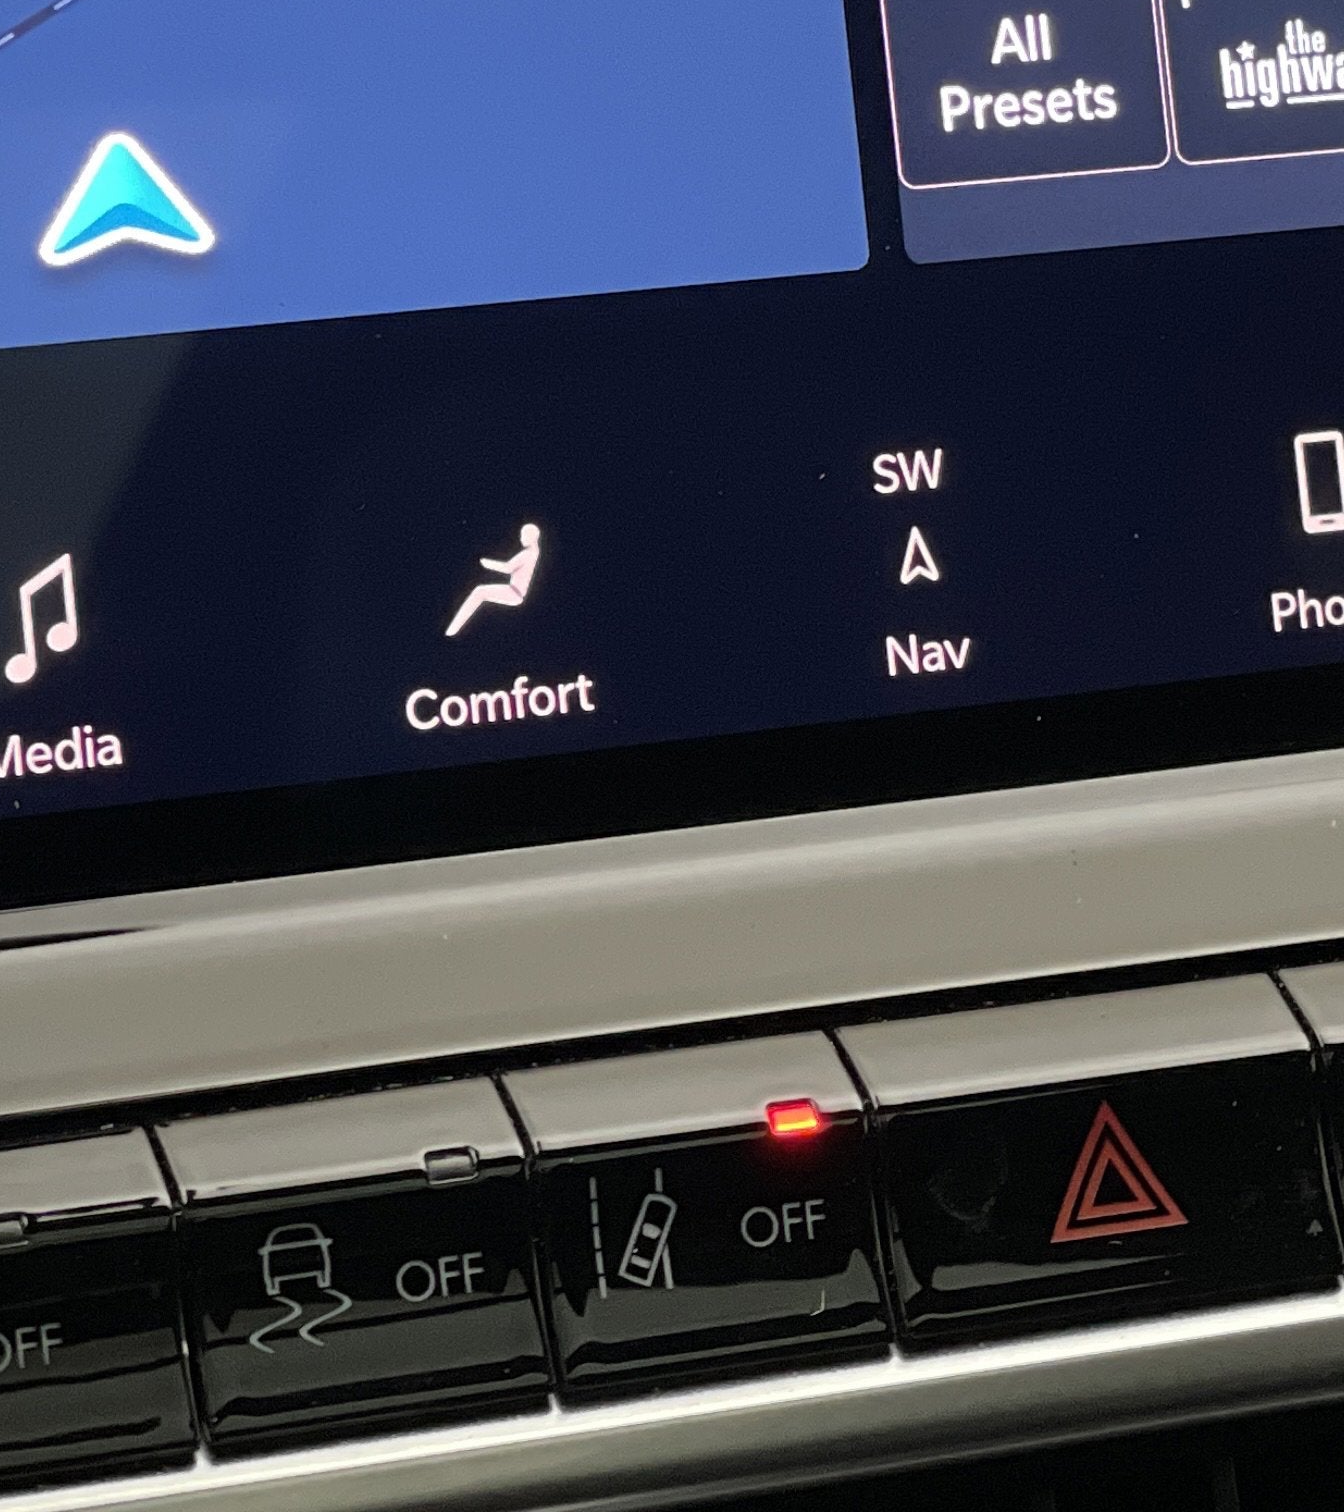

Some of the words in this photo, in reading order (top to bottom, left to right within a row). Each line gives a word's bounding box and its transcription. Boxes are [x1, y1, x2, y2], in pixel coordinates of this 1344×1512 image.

[990, 13, 1052, 65] All
[1284, 18, 1327, 56] the
[939, 79, 1118, 133] Presets
[871, 448, 944, 494] SW
[884, 631, 973, 678] Nav
[405, 674, 596, 733] Comfort
[739, 1198, 827, 1248] OFF
[394, 1252, 486, 1302] OFF
